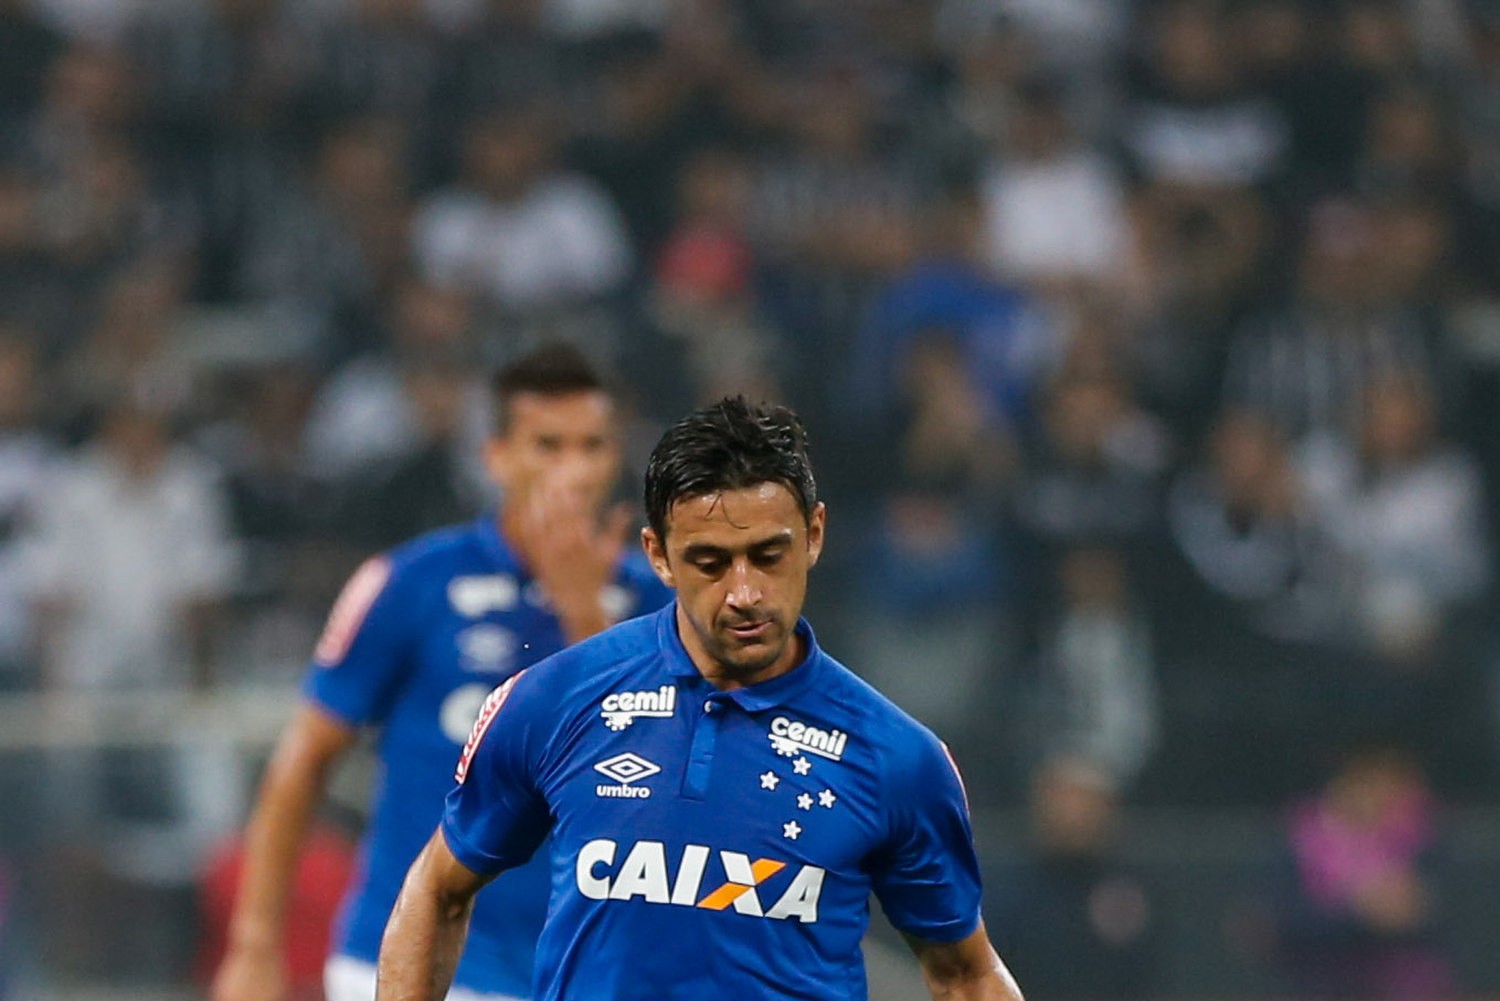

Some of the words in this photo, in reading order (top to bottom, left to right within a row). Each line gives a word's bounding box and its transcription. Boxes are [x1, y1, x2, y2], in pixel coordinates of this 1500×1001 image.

[601, 685, 676, 713] cemil
[771, 716, 847, 755] cemil
[596, 782, 651, 799] umbro
[576, 838, 826, 924] CAIXA
